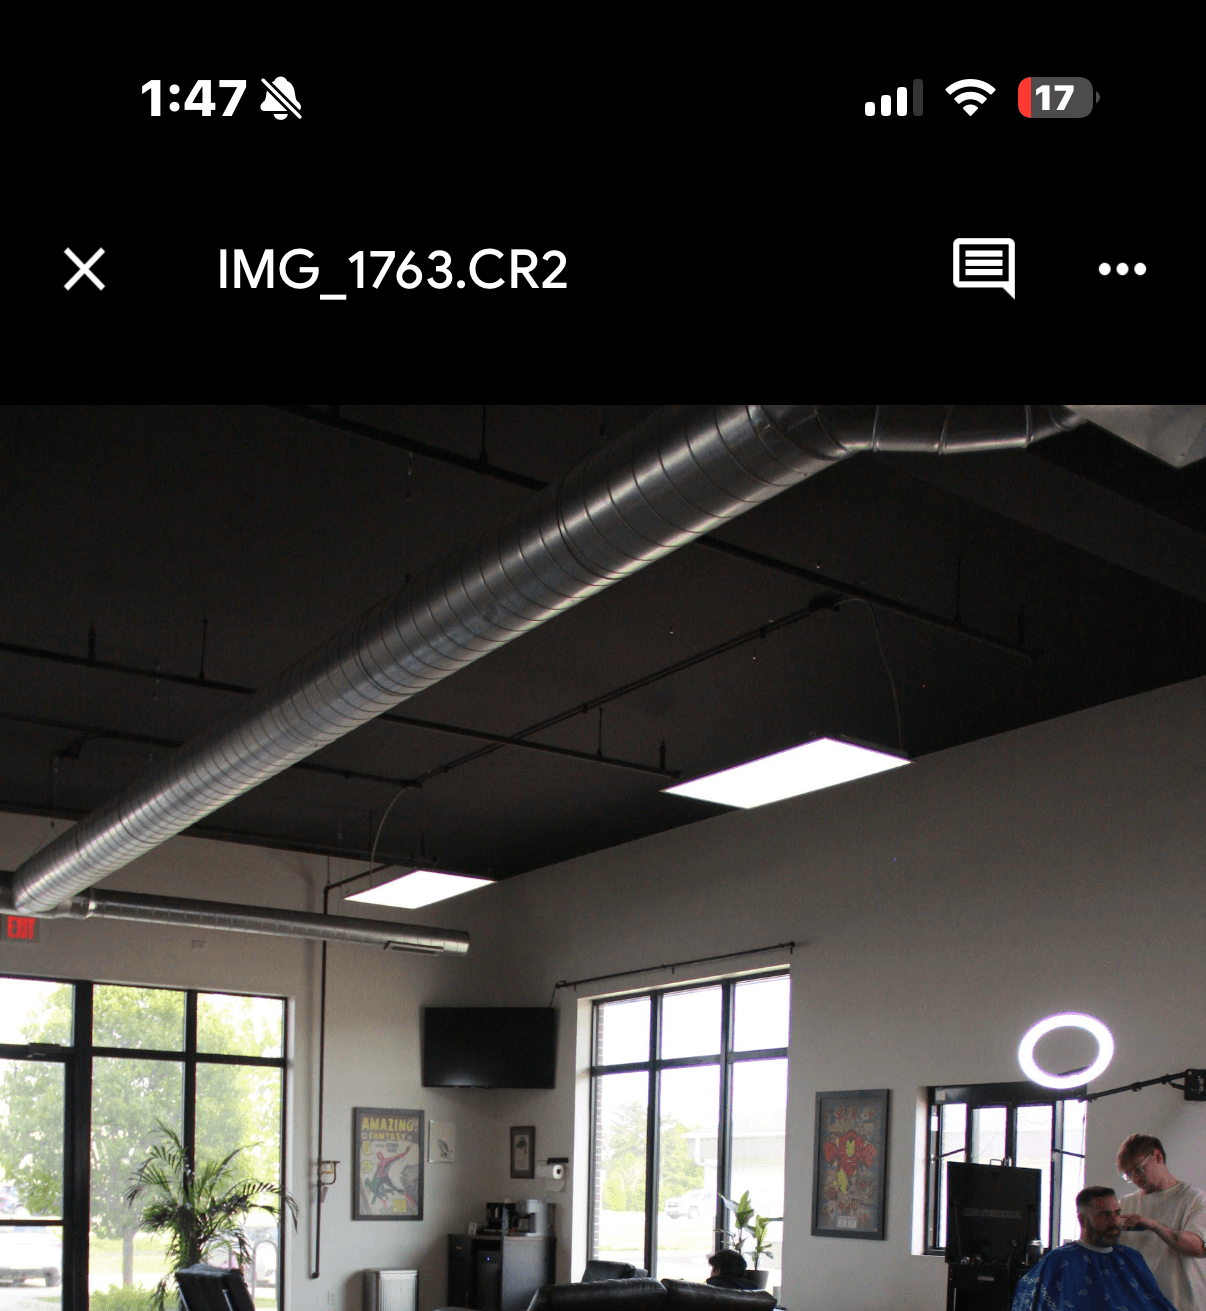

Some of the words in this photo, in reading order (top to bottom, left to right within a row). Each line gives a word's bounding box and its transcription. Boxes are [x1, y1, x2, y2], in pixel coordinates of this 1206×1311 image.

[7, 915, 36, 939] EXIT
[362, 1117, 413, 1131] AMAZING
[369, 1132, 405, 1140] FANTASY
